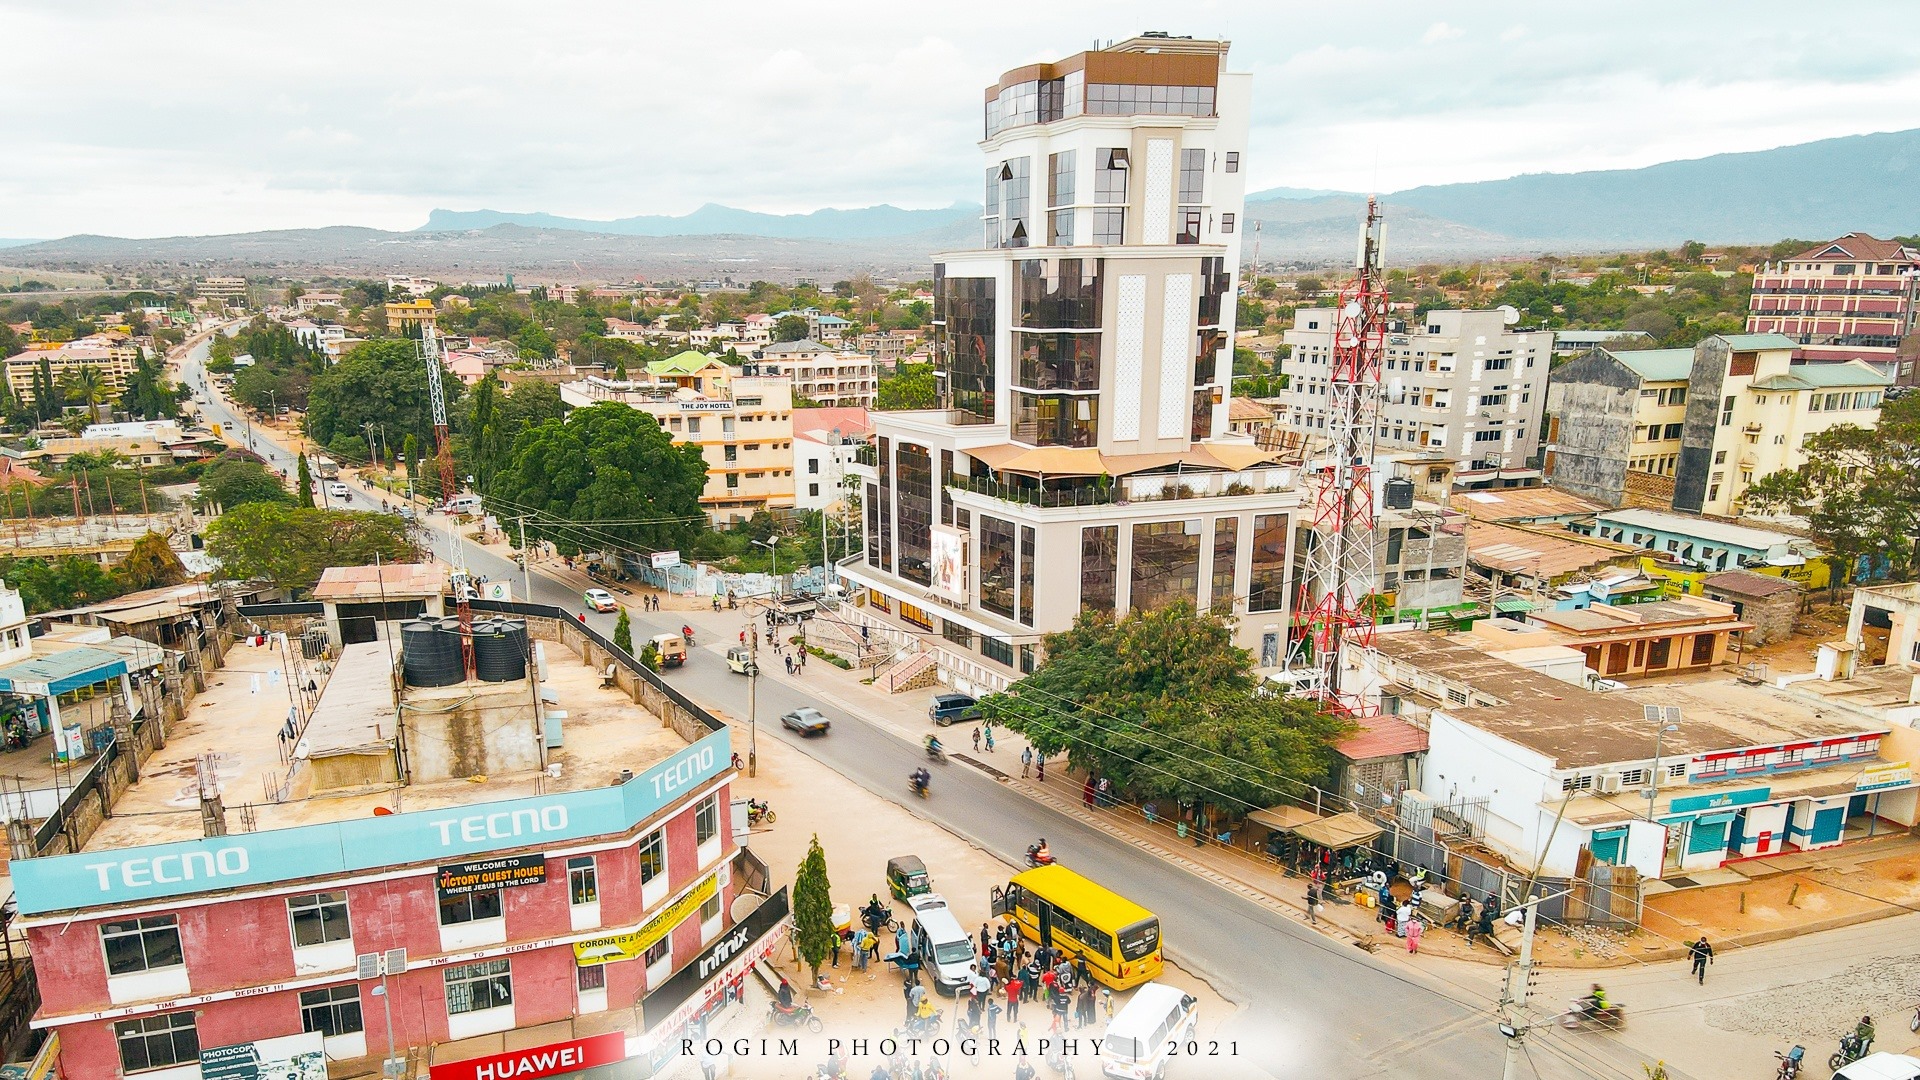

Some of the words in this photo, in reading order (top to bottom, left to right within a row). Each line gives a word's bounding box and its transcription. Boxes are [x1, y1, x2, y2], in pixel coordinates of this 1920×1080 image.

[650, 745, 714, 799] TECNO
[430, 805, 568, 846] TECNO
[84, 846, 250, 892] TECNO
[440, 871, 480, 888] VICTORY
[482, 870, 512, 882] GUEST
[513, 866, 545, 878] HOUSE
[464, 860, 506, 872] WELCOME
[446, 885, 473, 895] WHERE
[474, 881, 496, 891] JESUS
[505, 879, 519, 887] THE
[520, 877, 539, 885] LORD
[579, 938, 616, 949] CORONA
[618, 936, 627, 944] IS
[699, 926, 748, 980] Infinix
[429, 957, 449, 965] TIME
[505, 943, 538, 953] REPENT
[155, 1001, 177, 1010] TIME
[234, 987, 269, 997] REPENT
[203, 1045, 255, 1059] PHOTOCOPY
[476, 1046, 584, 1080] HUAWEI
